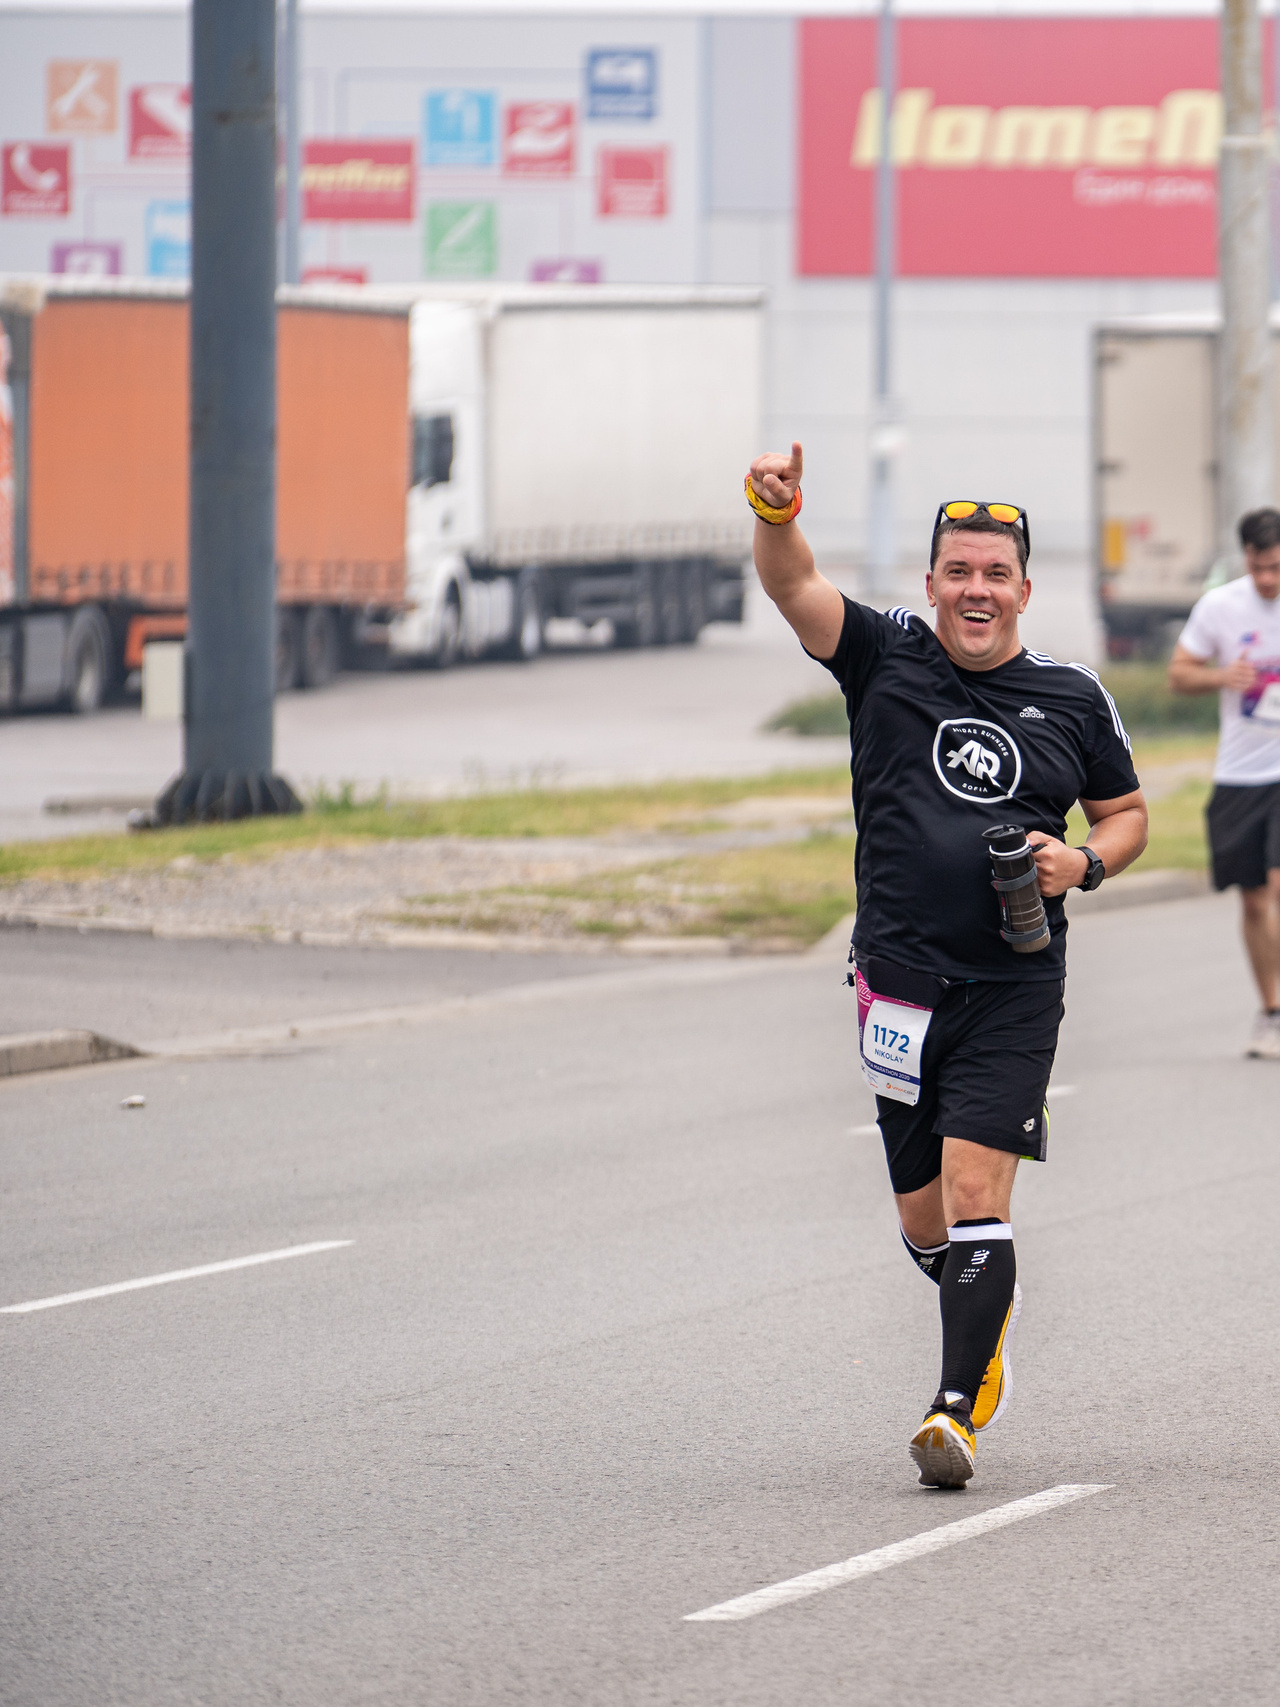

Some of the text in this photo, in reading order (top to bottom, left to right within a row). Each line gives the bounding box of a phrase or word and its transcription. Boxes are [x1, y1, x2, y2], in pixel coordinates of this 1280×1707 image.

[1019, 711, 1045, 719] adidas
[981, 729, 1009, 757] RUNNERS
[946, 739, 1001, 788] AR
[962, 782, 988, 793] SOFIA
[873, 1024, 910, 1054] 1172
[874, 1048, 904, 1064] NIKOLAY
[873, 1064, 898, 1077] MARATHON
[898, 1073, 911, 1081] 2020
